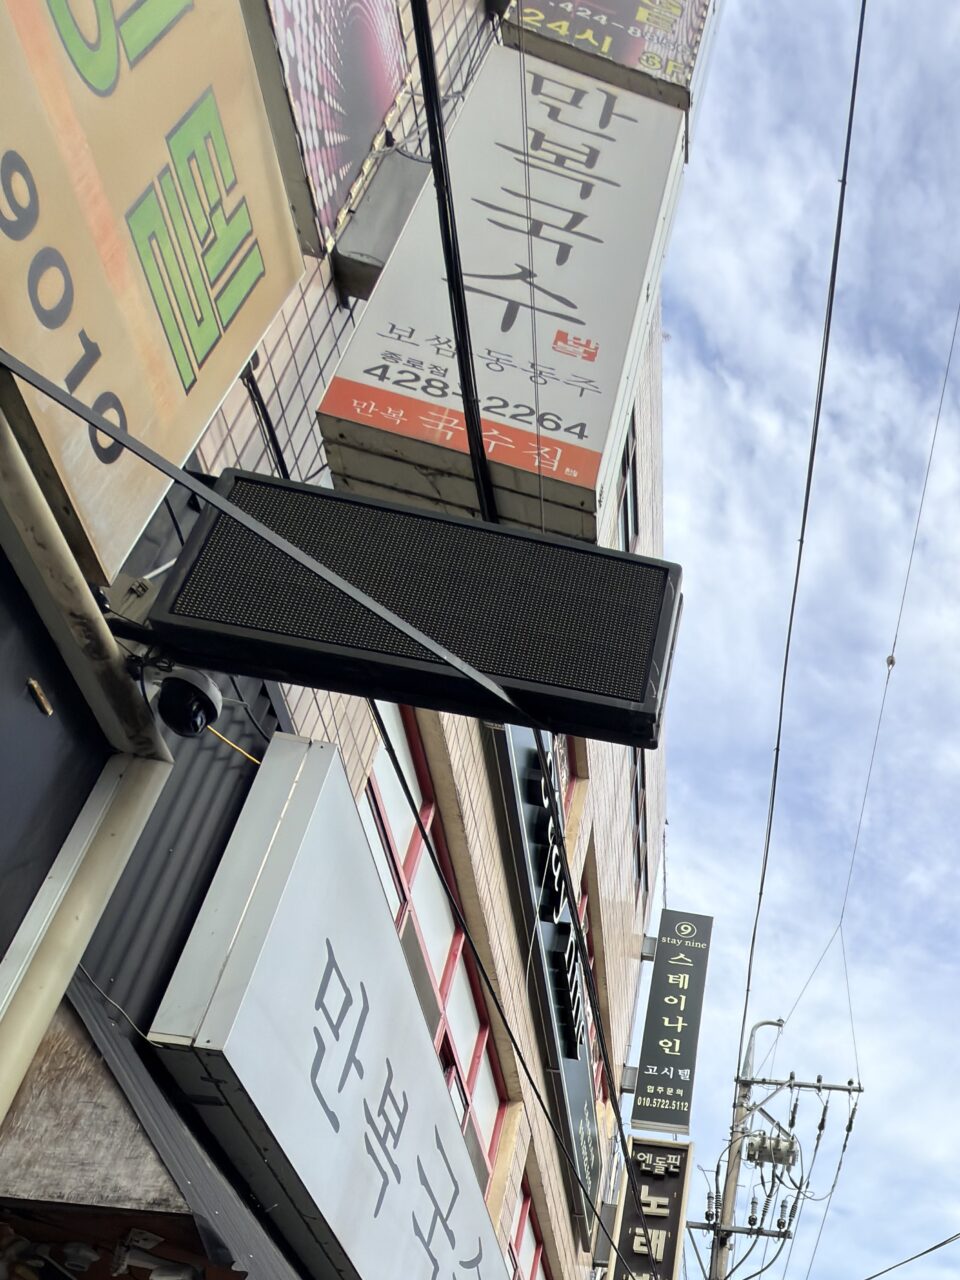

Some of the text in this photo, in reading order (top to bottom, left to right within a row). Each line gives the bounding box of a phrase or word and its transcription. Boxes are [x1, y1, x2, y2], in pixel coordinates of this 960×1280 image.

[522, 8, 613, 54] 24시
[441, 69, 638, 333] 만복국수
[379, 350, 449, 378] 종로점
[476, 347, 602, 397] 동동주
[351, 398, 408, 426] 만복
[661, 936, 707, 949] stay nine
[658, 952, 694, 1056] 스테이나인
[644, 1065, 691, 1081] 고시텔
[636, 1152, 682, 1175] 엔돌핀
